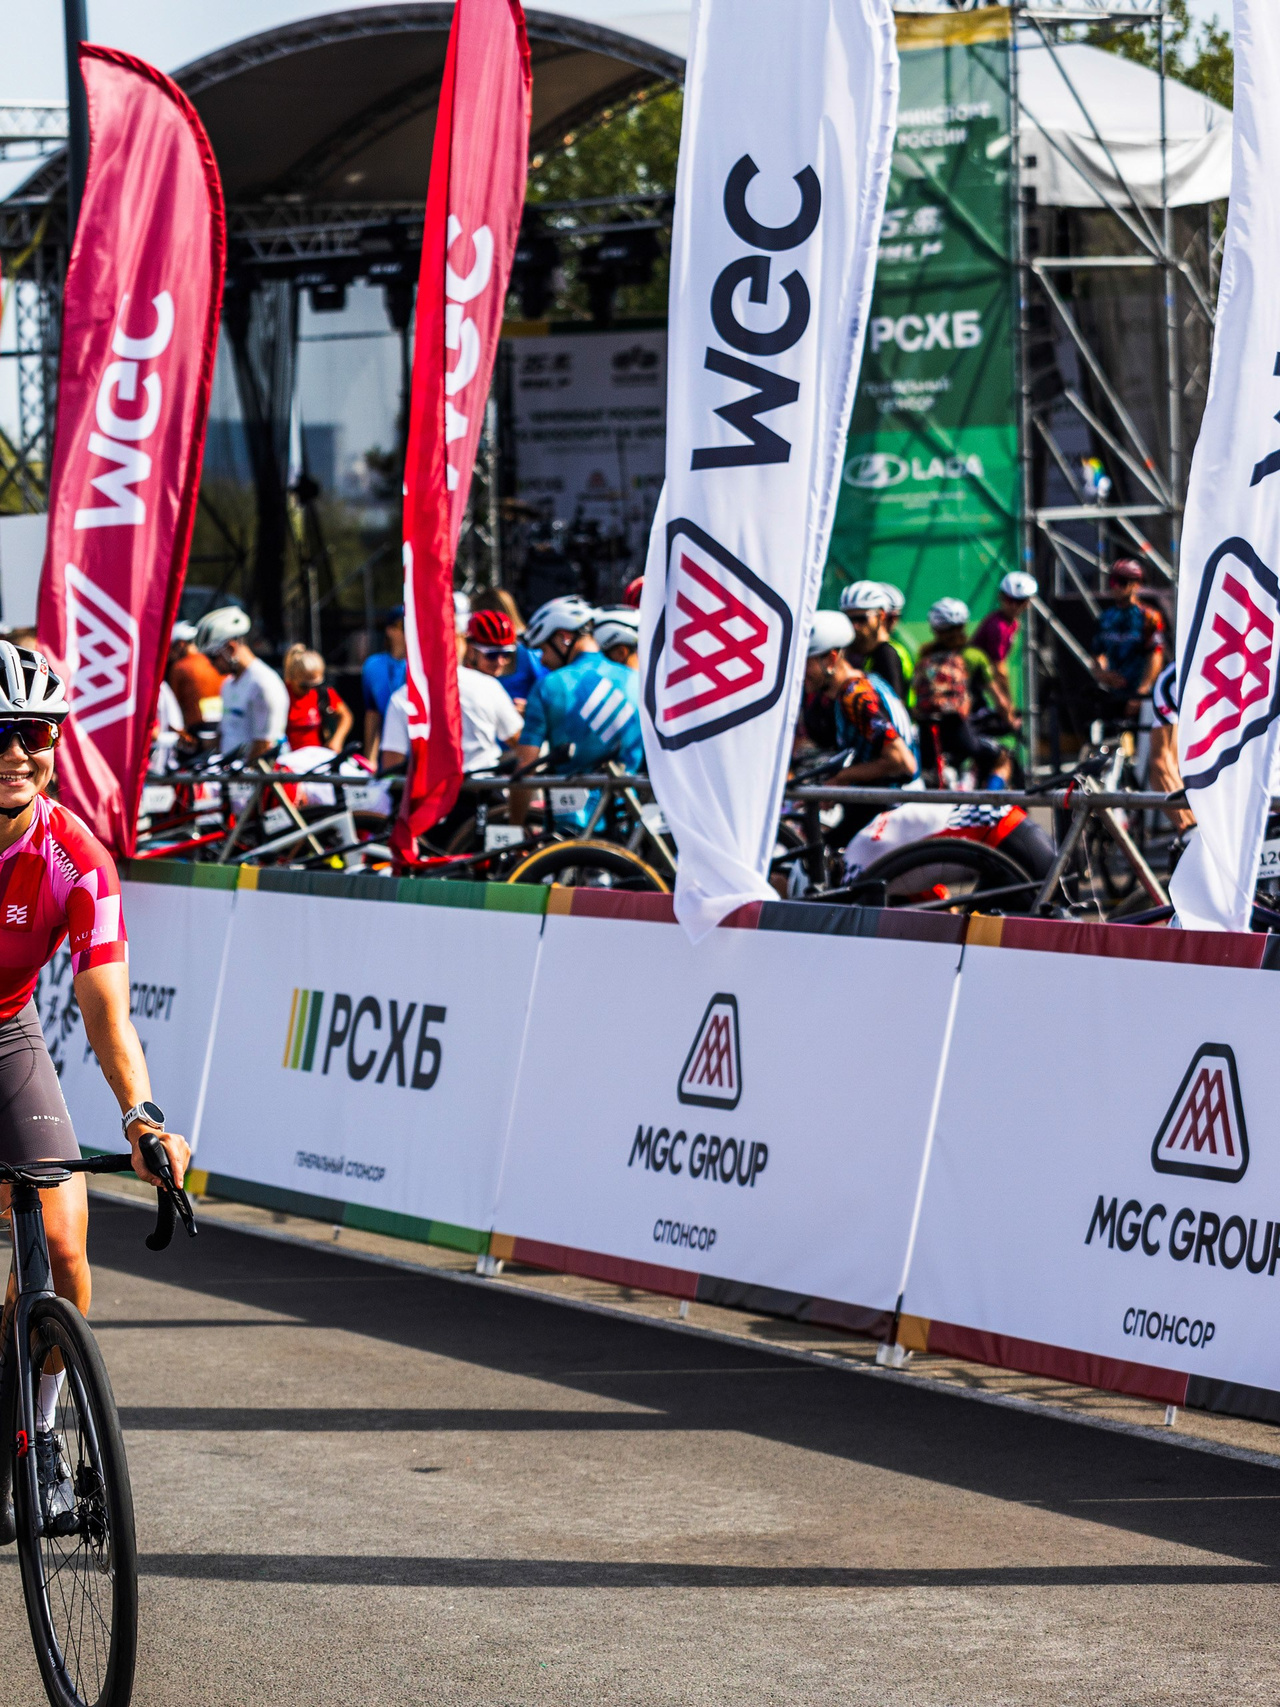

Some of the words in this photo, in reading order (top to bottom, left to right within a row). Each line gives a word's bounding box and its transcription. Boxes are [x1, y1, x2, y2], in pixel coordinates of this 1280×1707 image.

[870, 311, 983, 353] РСХБ
[1260, 851, 1280, 866] 12
[129, 982, 177, 1021] СПОРТ
[321, 992, 448, 1091] РСХБ
[628, 1124, 687, 1175] MGC
[688, 1133, 769, 1188] GROUP
[652, 1219, 717, 1252] СПОНСОР
[1084, 1195, 1167, 1257] MGC
[1122, 1307, 1216, 1349] СПОНСОР
